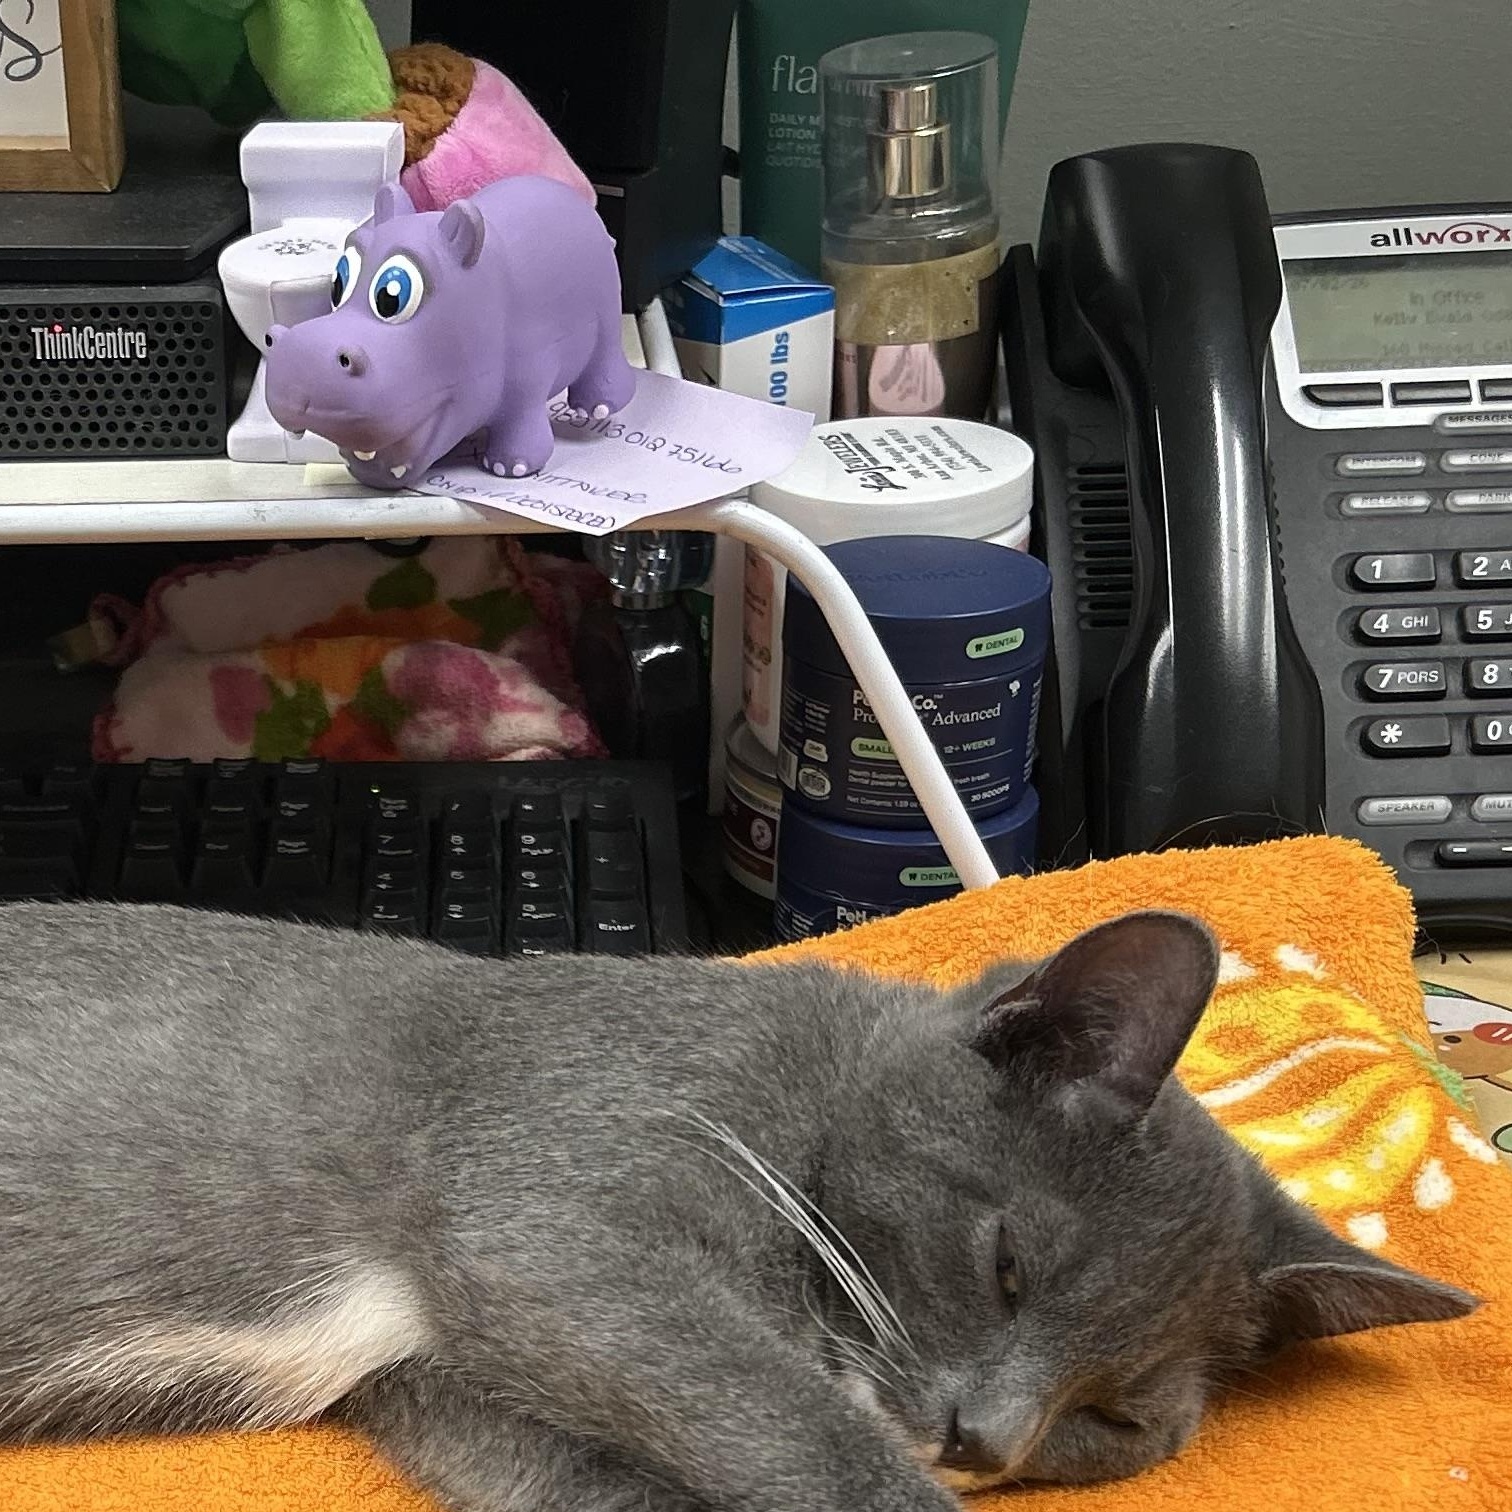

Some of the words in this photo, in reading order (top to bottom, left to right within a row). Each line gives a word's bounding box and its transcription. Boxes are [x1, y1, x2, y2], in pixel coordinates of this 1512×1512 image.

[1370, 222, 1512, 248] allworx
[31, 324, 147, 360] ThinkCentre
[770, 331, 790, 365] lbs
[1447, 413, 1512, 424] MESSAGES
[1370, 559, 1383, 580] 1
[1472, 556, 1489, 577] 2
[1373, 613, 1389, 633] 4
[1401, 616, 1429, 629] GHI
[1477, 609, 1493, 630] 5
[985, 635, 1019, 650] DENTAL
[1378, 668, 1393, 689] 7
[1397, 670, 1439, 684] PQRS
[1482, 663, 1499, 685] 8
[931, 703, 1002, 727] Advanced
[1487, 720, 1502, 741] 0
[1377, 803, 1436, 814] SPEAKER
[1484, 799, 1512, 811] MUT
[920, 871, 958, 881] DENTAL
[597, 922, 636, 932] Enter
